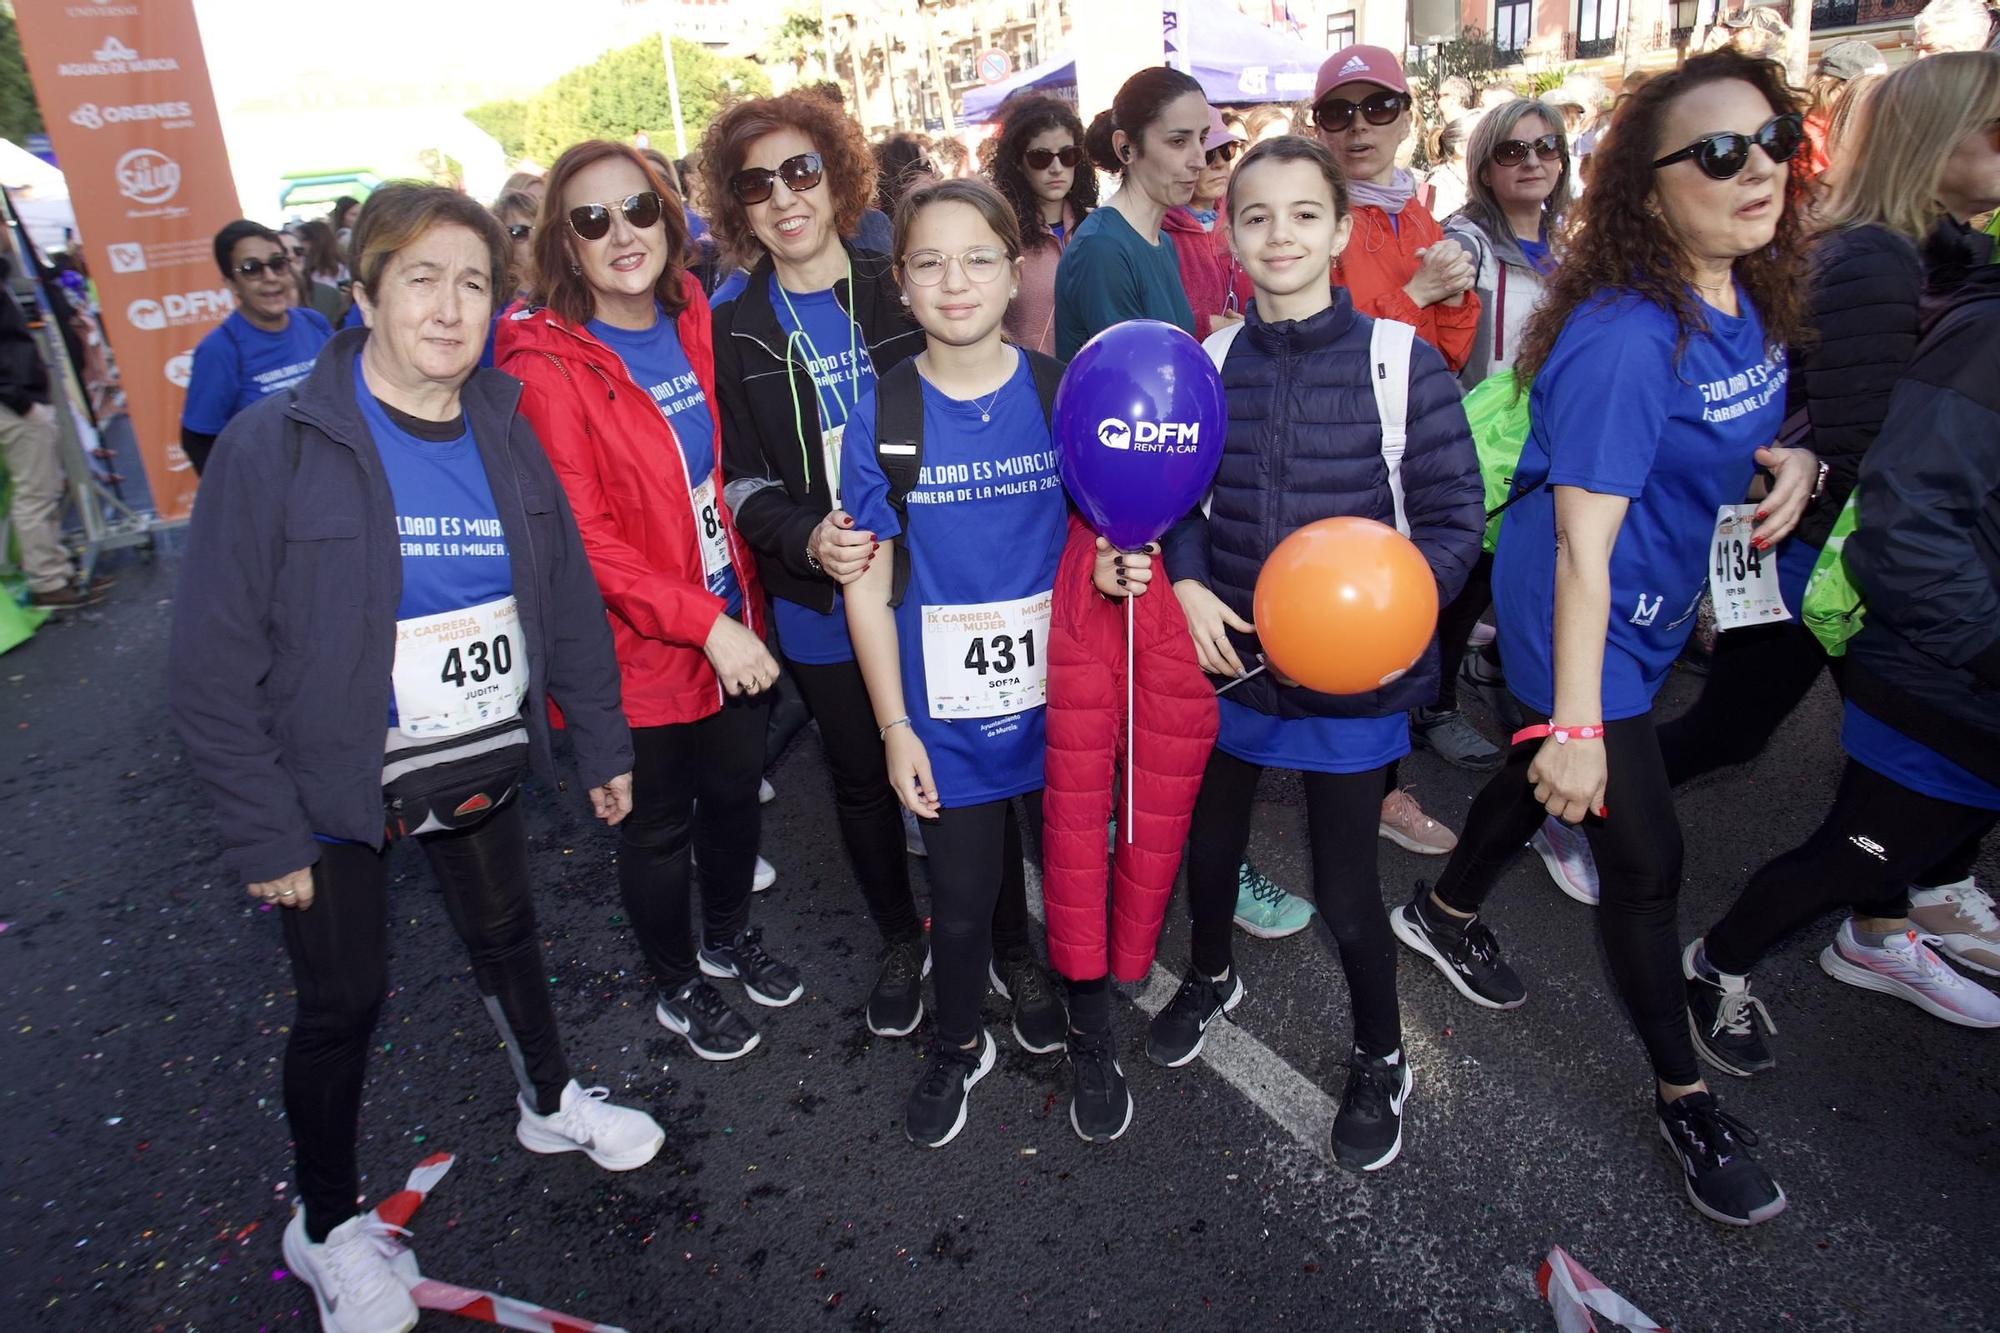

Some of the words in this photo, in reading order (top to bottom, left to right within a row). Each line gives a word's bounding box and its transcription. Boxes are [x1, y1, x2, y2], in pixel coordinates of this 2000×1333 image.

[103, 102, 192, 122] ORENES
[162, 288, 233, 318] DFM
[1134, 421, 1200, 444] DFM
[1134, 443, 1164, 452] RENT
[1166, 445, 1174, 453] A
[1177, 445, 1197, 453] CAR
[973, 461, 992, 481] ES
[906, 492, 955, 505] CARRERA
[957, 488, 973, 501] DE
[976, 485, 992, 499] LA
[994, 481, 1037, 497] MUJER
[440, 516, 461, 537] ES
[425, 543, 441, 556] DE
[444, 543, 460, 556] LA
[462, 543, 505, 556] MUJER
[1716, 540, 1762, 583] 4134
[414, 617, 476, 638] CARRERA
[928, 613, 939, 624] IX
[942, 611, 1002, 624] CARRERA
[963, 620, 1007, 632] MUJER
[438, 626, 481, 643] MUJER
[441, 634, 512, 688] 430
[964, 629, 1036, 676] 431
[465, 684, 499, 701] JUDITH
[988, 677, 1021, 689] SOF?A
[980, 714, 1022, 733] Ayuntamiento
[987, 728, 997, 738] de
[996, 724, 1019, 736] Murcia
